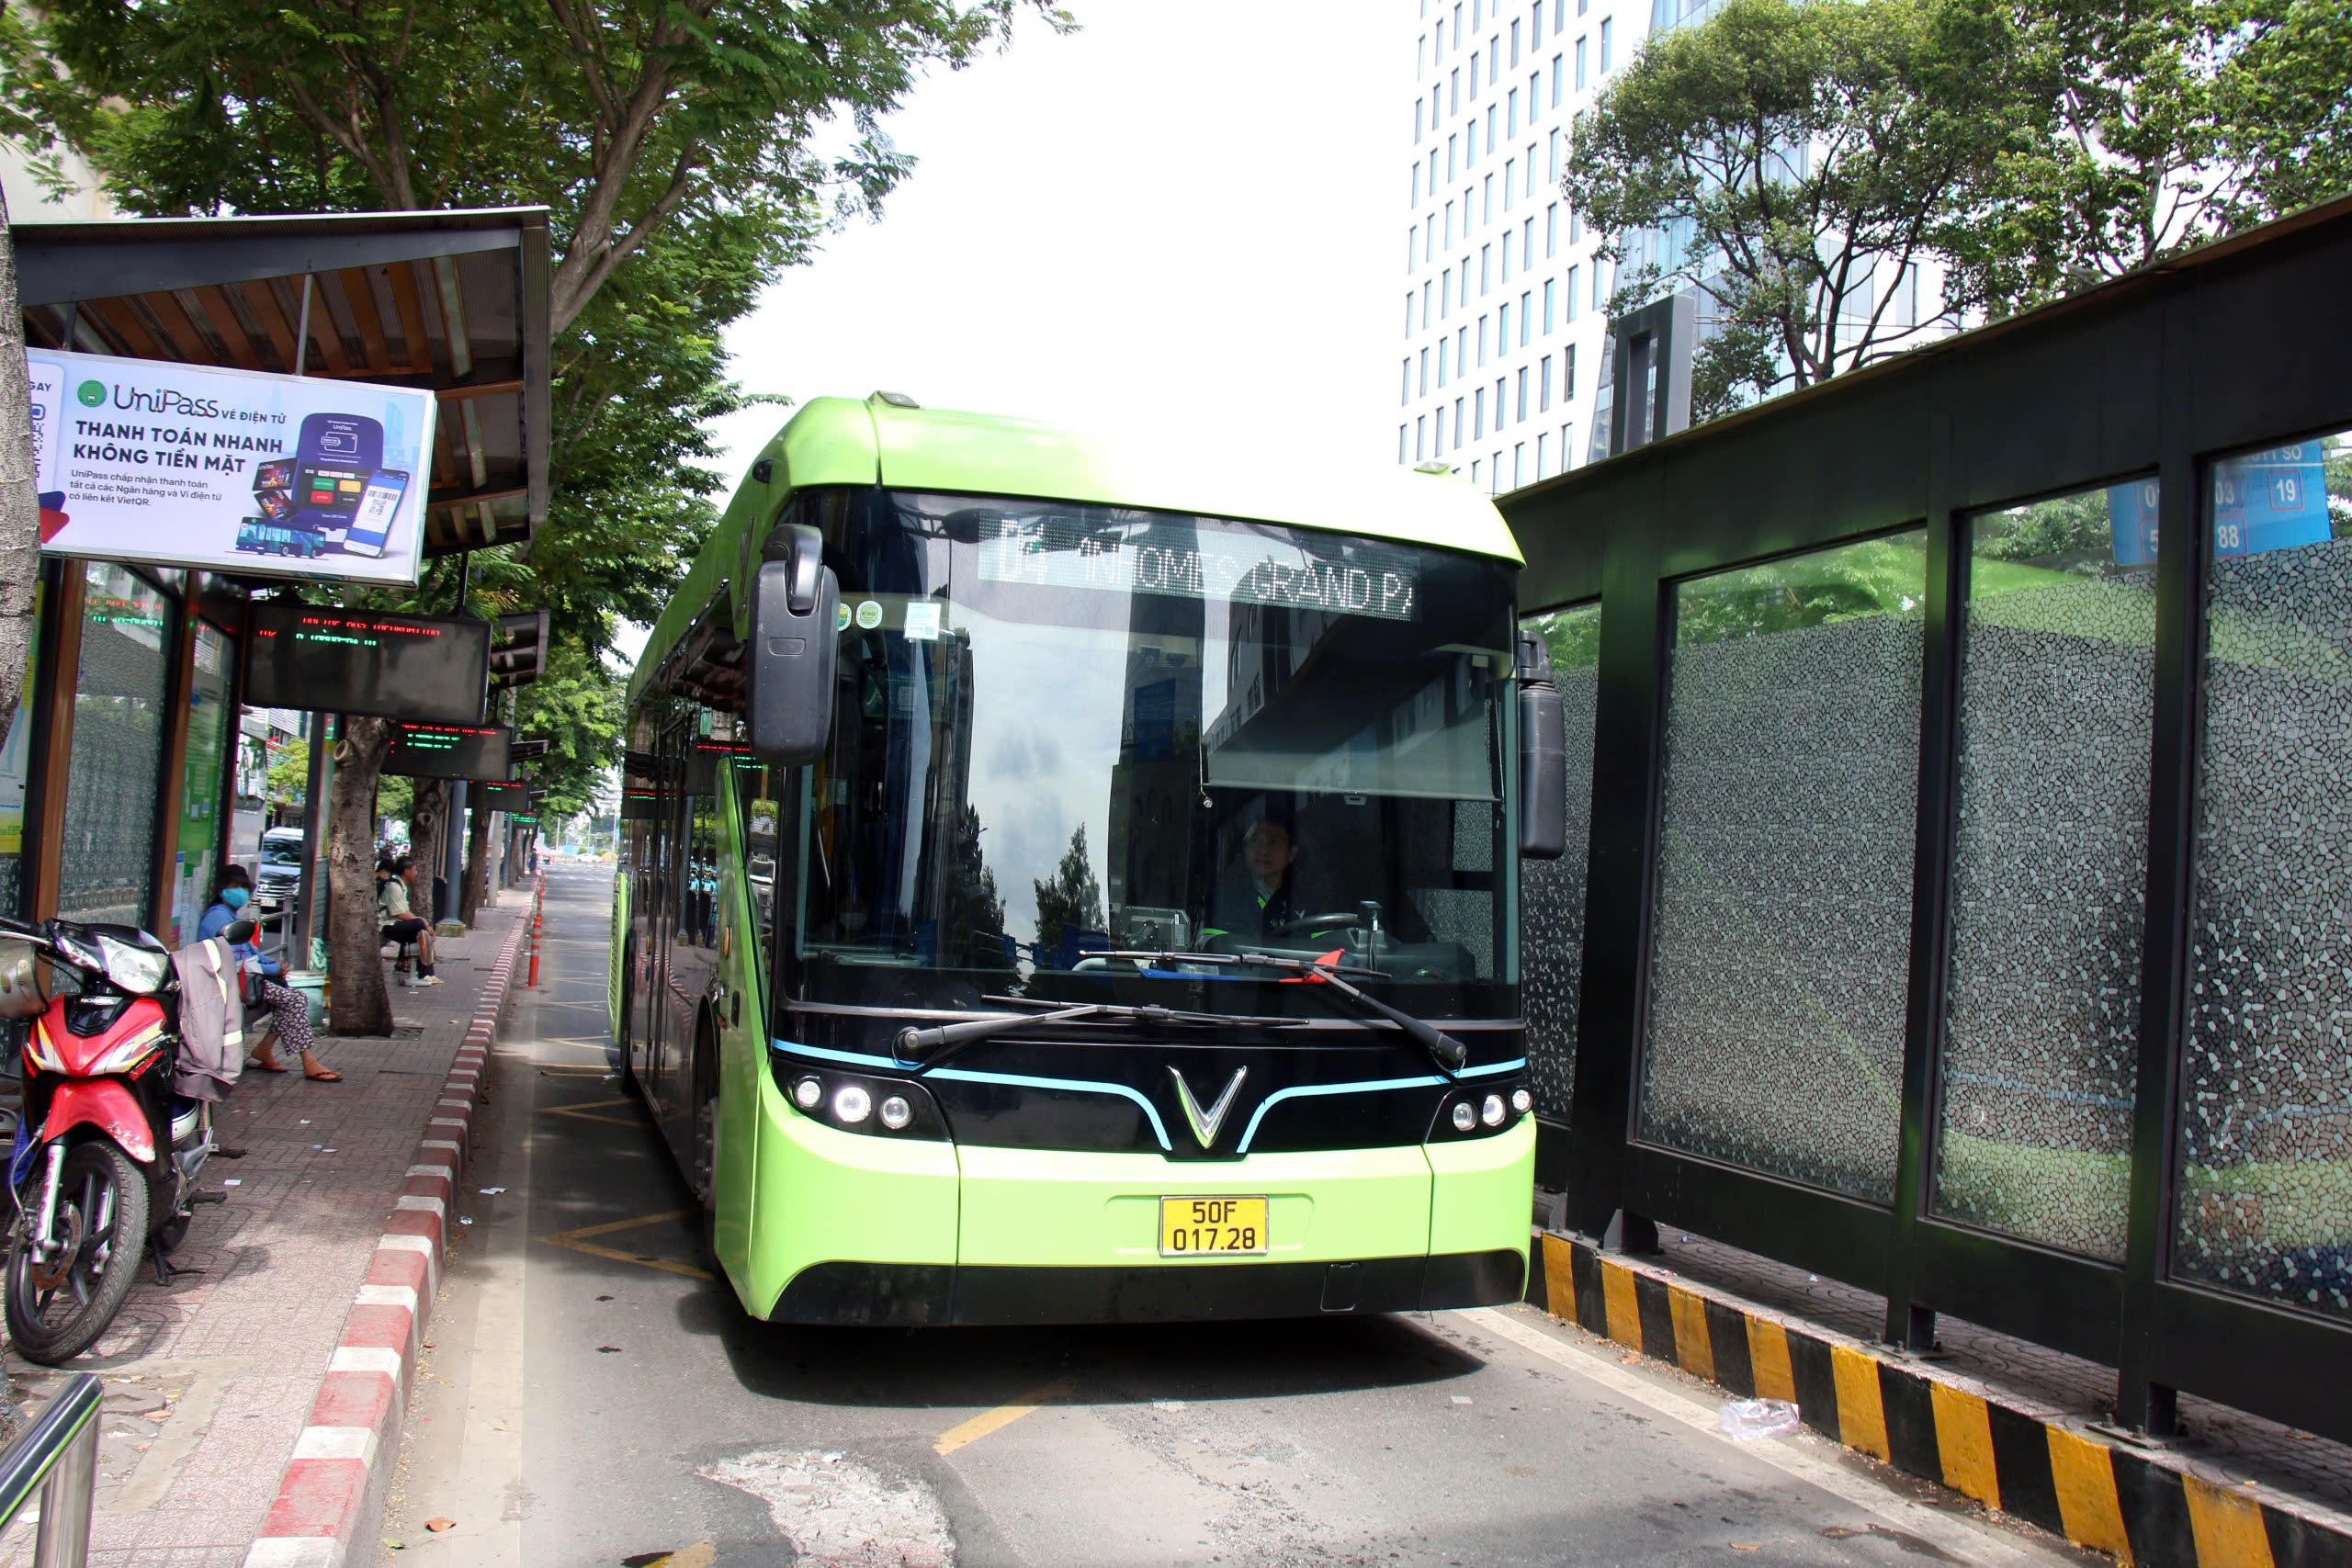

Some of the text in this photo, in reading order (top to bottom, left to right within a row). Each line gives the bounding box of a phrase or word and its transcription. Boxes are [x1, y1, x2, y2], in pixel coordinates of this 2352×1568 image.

[114, 384, 220, 418] UniPass
[221, 409, 287, 424] VÉ ĐIỆN TỬ
[75, 420, 283, 453] THANH TOÁN NHANH
[74, 442, 245, 476] KHÔNG TIỀN MẶT
[70, 479, 83, 489] tất
[97, 483, 114, 491] các
[116, 485, 141, 494] Ngân
[142, 487, 165, 497] hàng
[167, 490, 177, 498] và
[190, 491, 210, 501] điện
[71, 469, 208, 489] UniPass chấp nhận thanh toán
[2276, 479, 2296, 502] 19
[82, 492, 98, 502] liên
[100, 493, 115, 503] kết
[117, 496, 151, 506] VietQR.
[2218, 525, 2239, 548] 88
[1252, 558, 1370, 609] GRAND
[1193, 1201, 1238, 1224] 50F
[1173, 1227, 1256, 1251] 017.28
